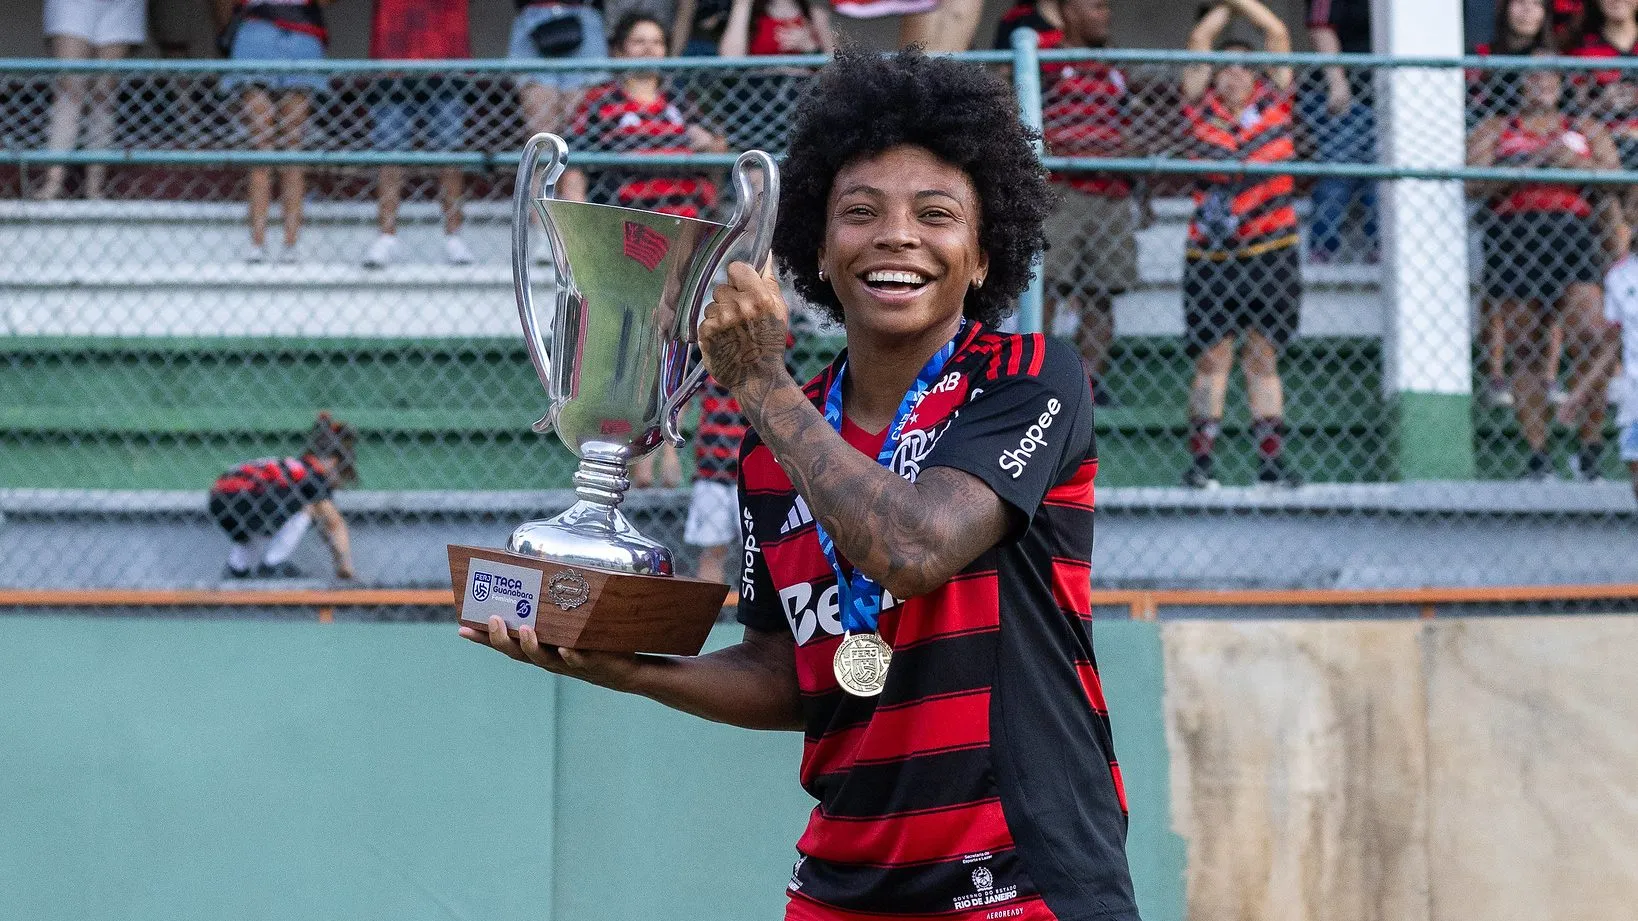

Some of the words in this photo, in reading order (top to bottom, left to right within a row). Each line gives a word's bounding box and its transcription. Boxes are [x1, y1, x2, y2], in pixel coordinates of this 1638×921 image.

[999, 398, 1061, 479] Shopee
[494, 575, 522, 590] TAÇA
[493, 586, 533, 600] Guanabara
[851, 649, 877, 658] FERJ
[953, 892, 982, 902] GOVERNO
[996, 884, 1017, 894] ESTADO
[954, 900, 971, 910] RIO
[972, 898, 983, 906] DE
[984, 890, 1017, 904] JANEIRO
[986, 907, 1024, 920] AEROREADY
